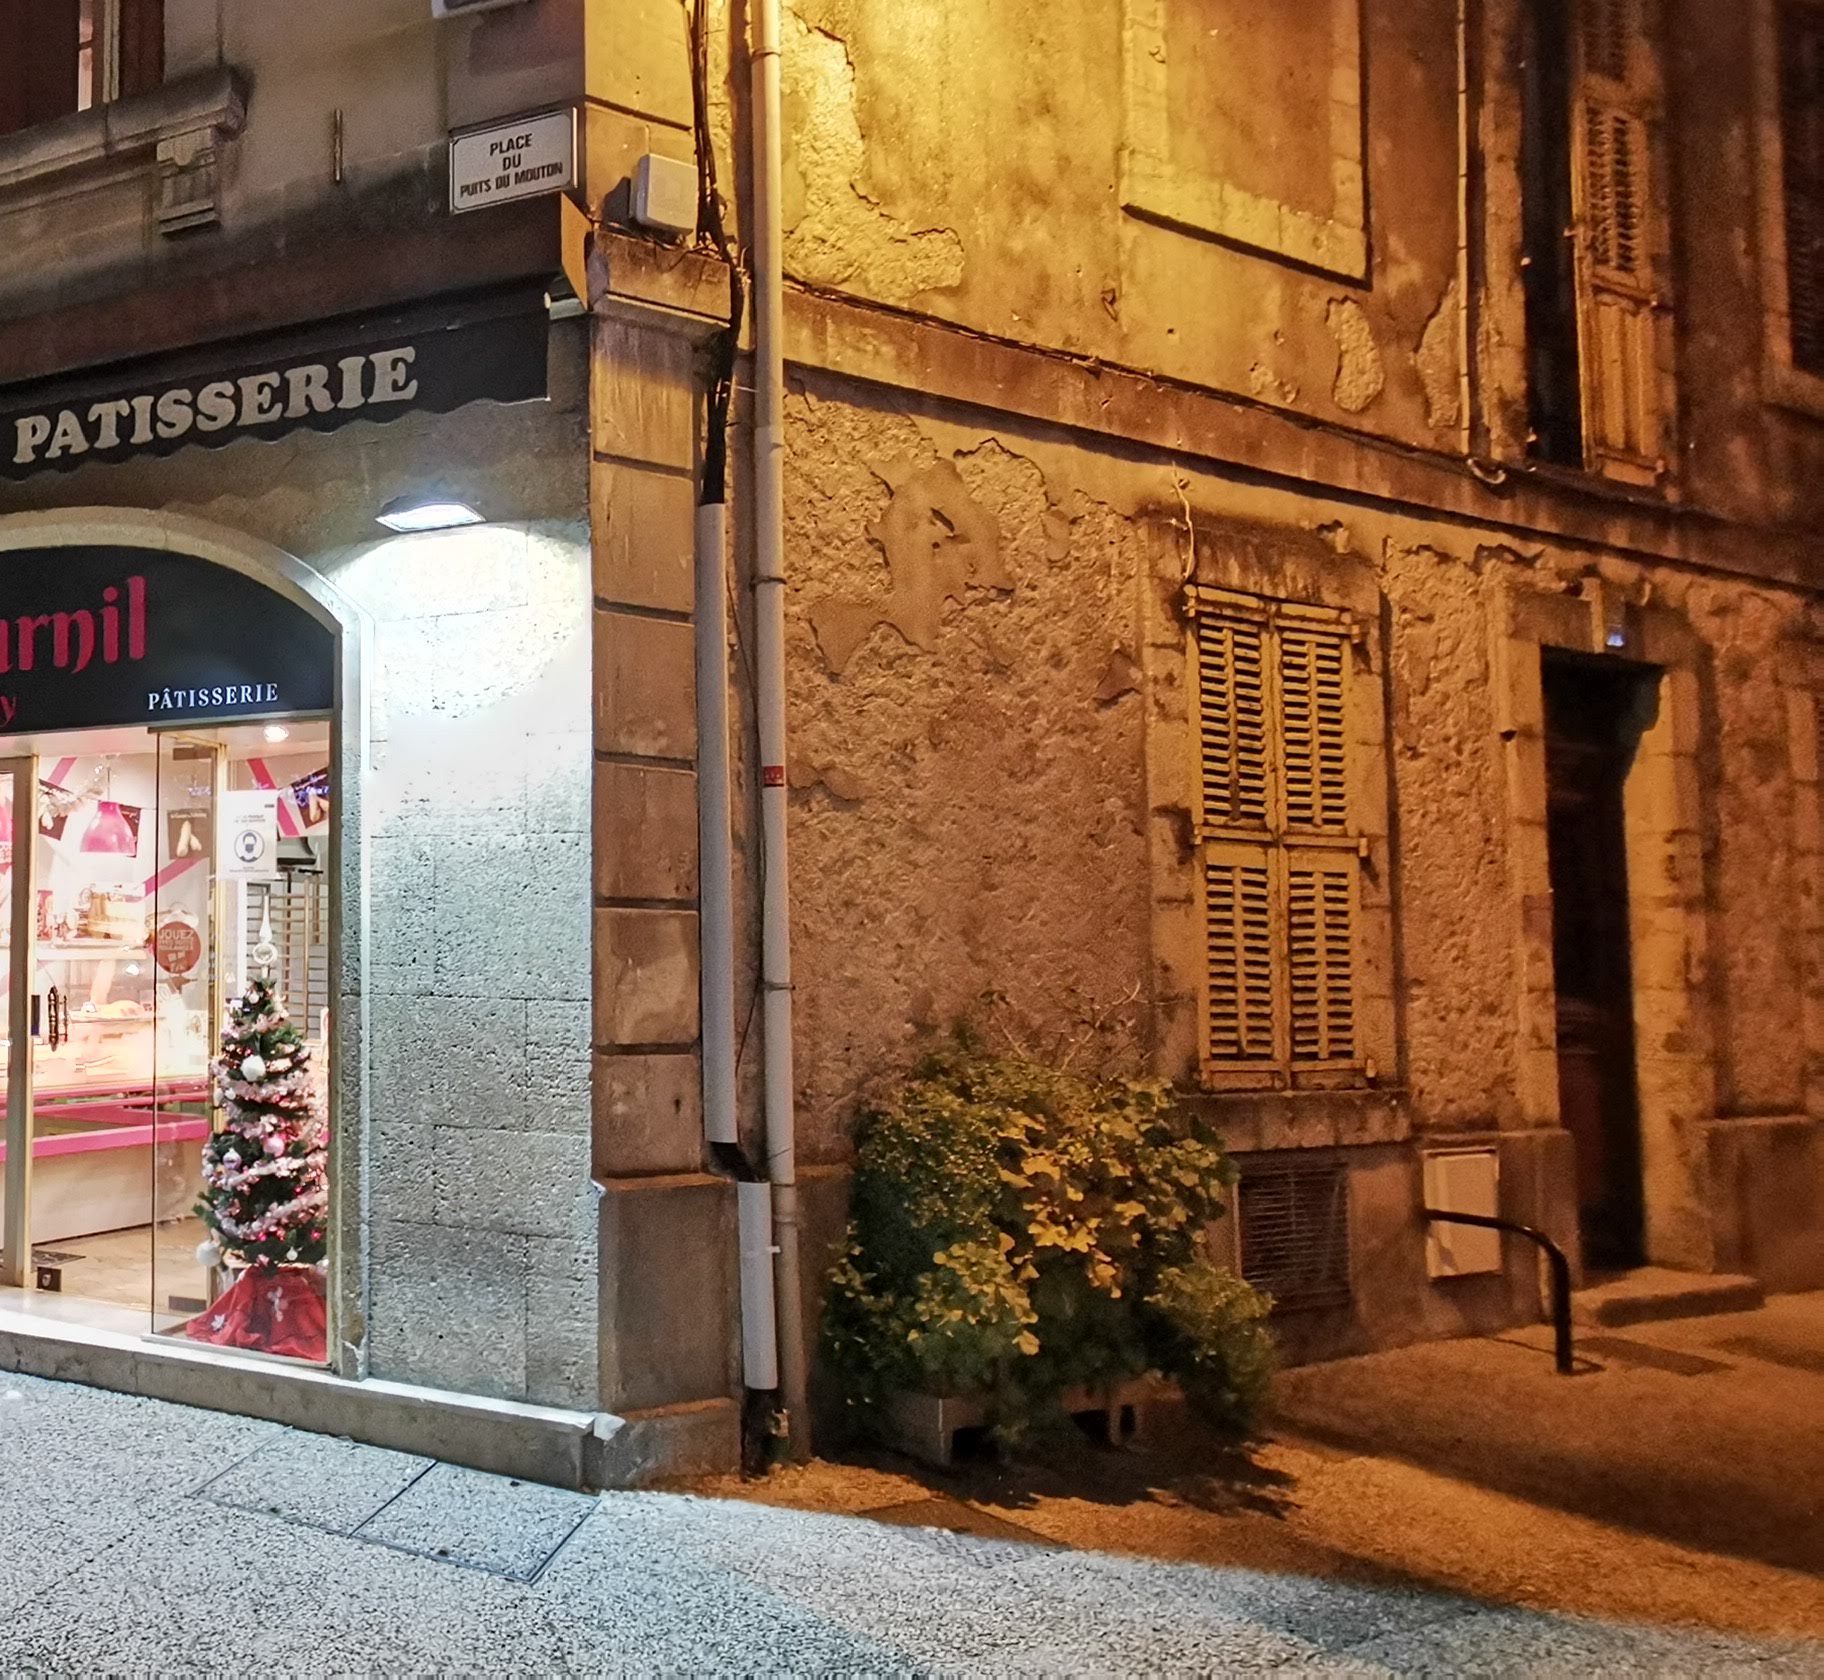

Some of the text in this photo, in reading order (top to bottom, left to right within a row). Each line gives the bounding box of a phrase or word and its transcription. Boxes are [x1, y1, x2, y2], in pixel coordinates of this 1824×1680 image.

[489, 133, 533, 157] PLACE
[502, 153, 522, 172] DU
[459, 161, 564, 198] PUITS DU MOUTON
[12, 345, 419, 464] PATISSERIE
[147, 683, 279, 711] PÂTISSERIE
